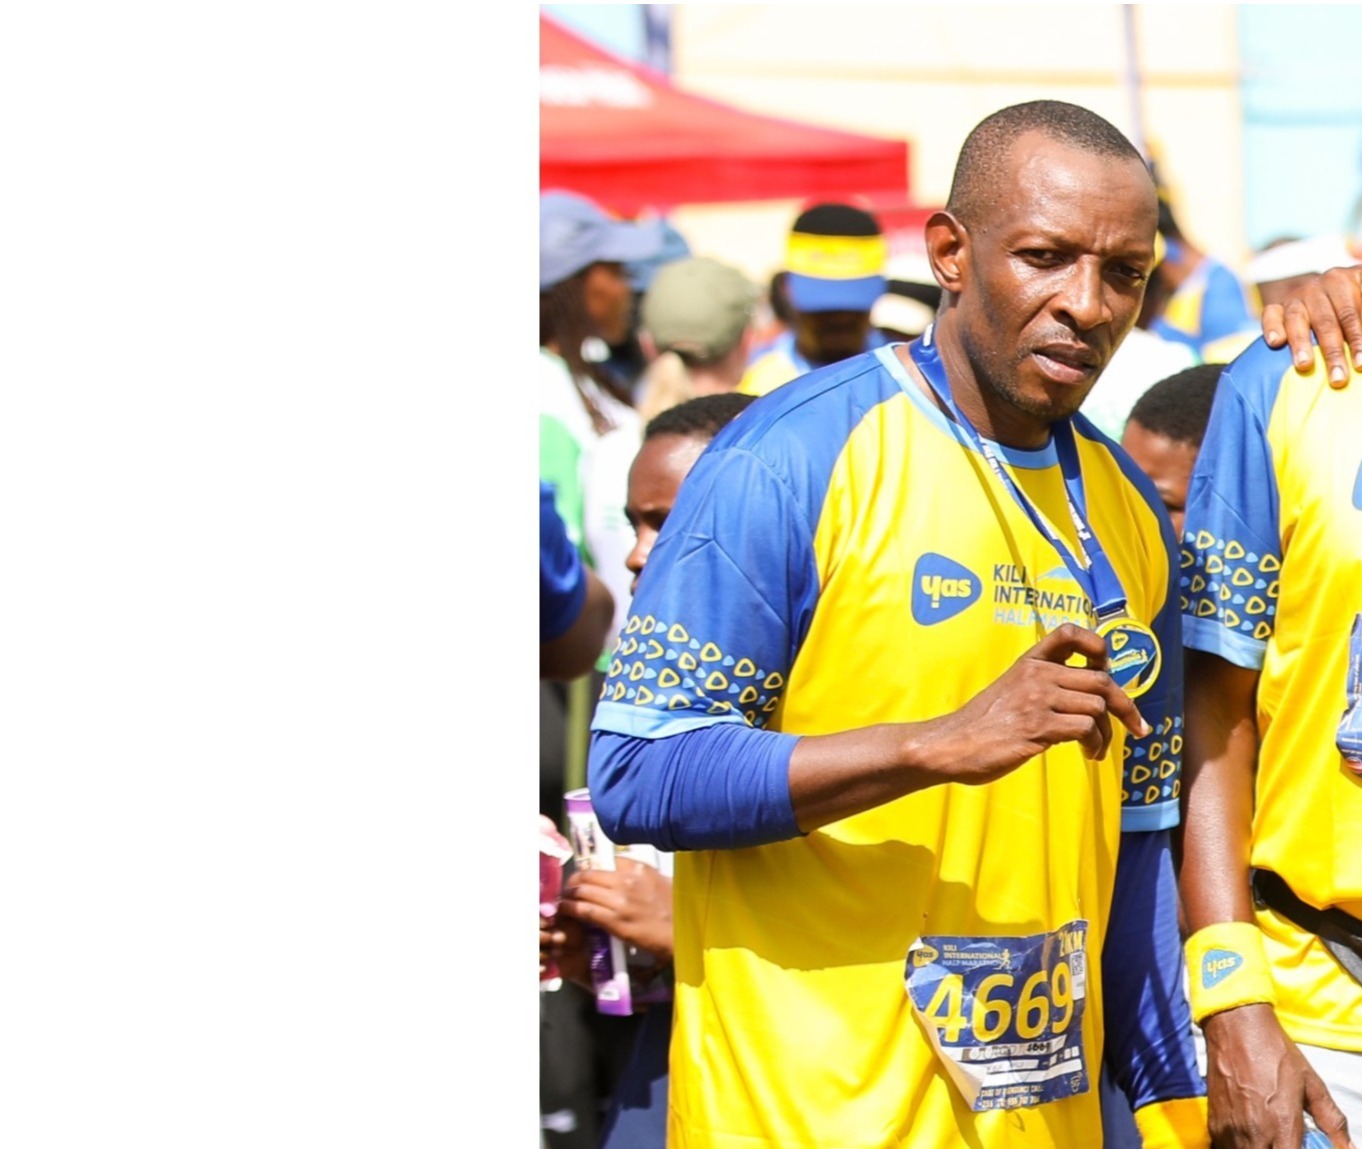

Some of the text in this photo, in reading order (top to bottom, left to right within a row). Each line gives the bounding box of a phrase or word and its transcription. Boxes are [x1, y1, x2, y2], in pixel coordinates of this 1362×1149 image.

[993, 564, 1026, 583] KILI
[921, 574, 972, 608] yas
[994, 585, 1094, 618] INTERNATIO
[1208, 954, 1236, 978] yas
[923, 961, 1074, 1043] 4669
